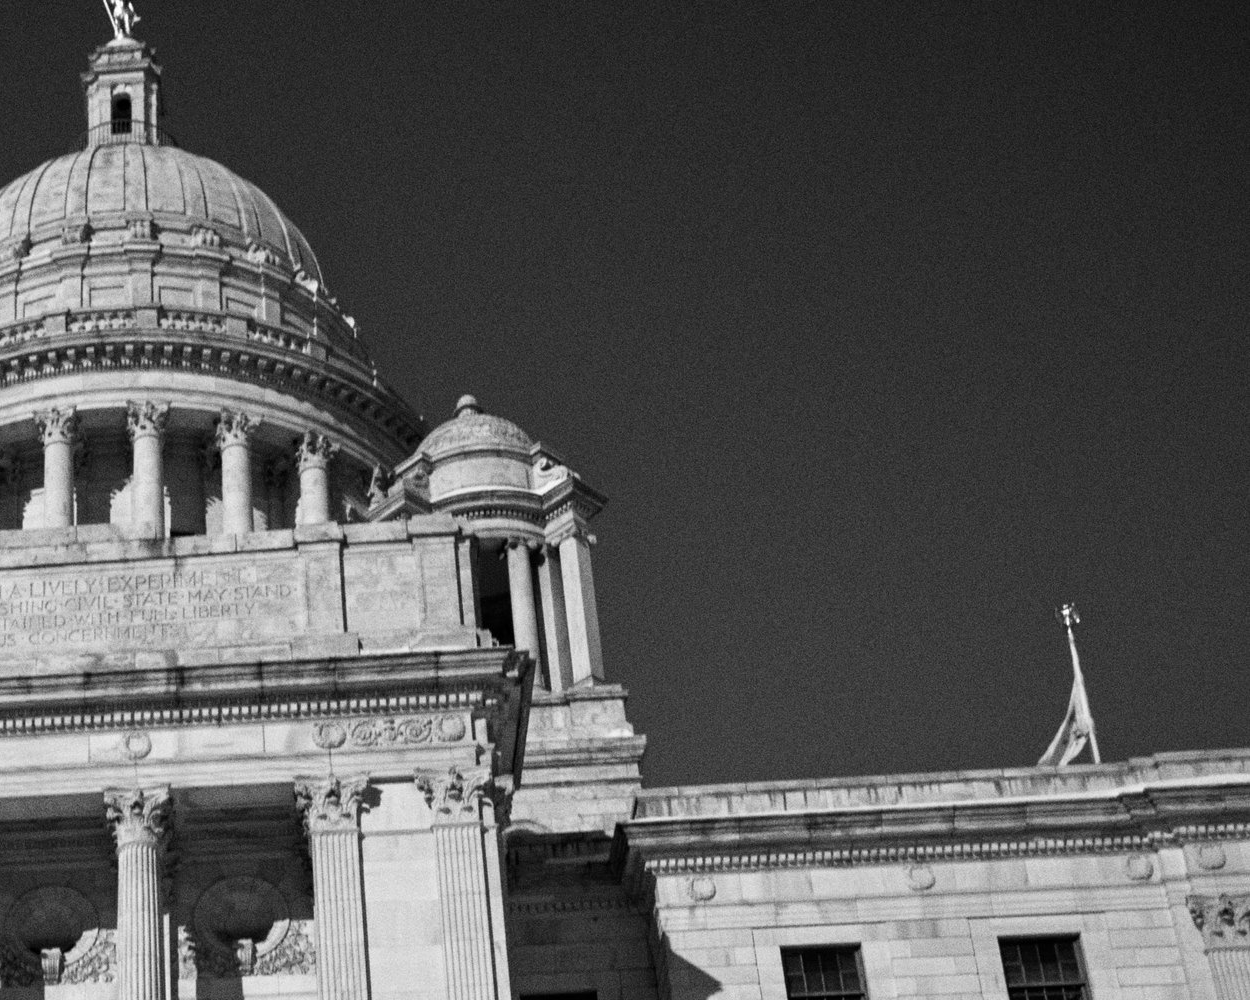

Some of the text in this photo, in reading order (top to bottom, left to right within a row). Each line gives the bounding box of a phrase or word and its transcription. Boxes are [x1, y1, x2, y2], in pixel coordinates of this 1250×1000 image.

[10, 583, 22, 599] A
[30, 578, 96, 597] LIVELY
[65, 595, 113, 612] CIVIL
[124, 591, 178, 608] STATE
[188, 588, 227, 604] MAY
[234, 584, 291, 601] STAND
[74, 610, 119, 626] WITH
[182, 602, 255, 620] LIBERTY
